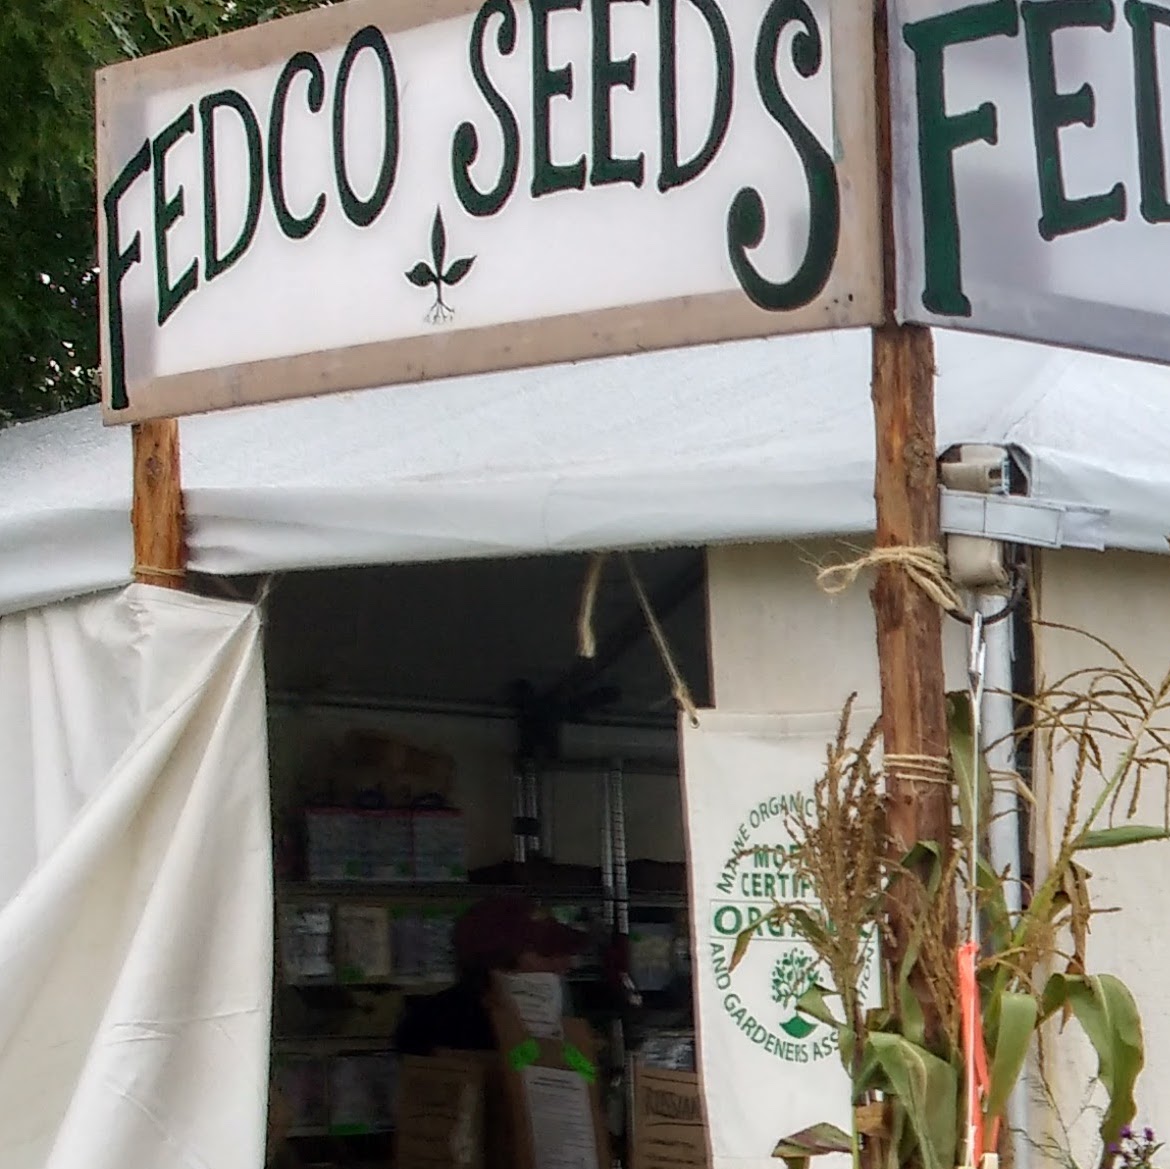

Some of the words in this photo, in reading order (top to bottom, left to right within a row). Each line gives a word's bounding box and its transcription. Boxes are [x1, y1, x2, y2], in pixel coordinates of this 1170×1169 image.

[105, 25, 399, 410] FEDCO
[452, 0, 840, 312] SEEDS
[716, 823, 751, 894] MAINE
[749, 794, 815, 829] ORGANIC
[710, 943, 732, 990] AND
[723, 993, 808, 1063] GARDENERS
